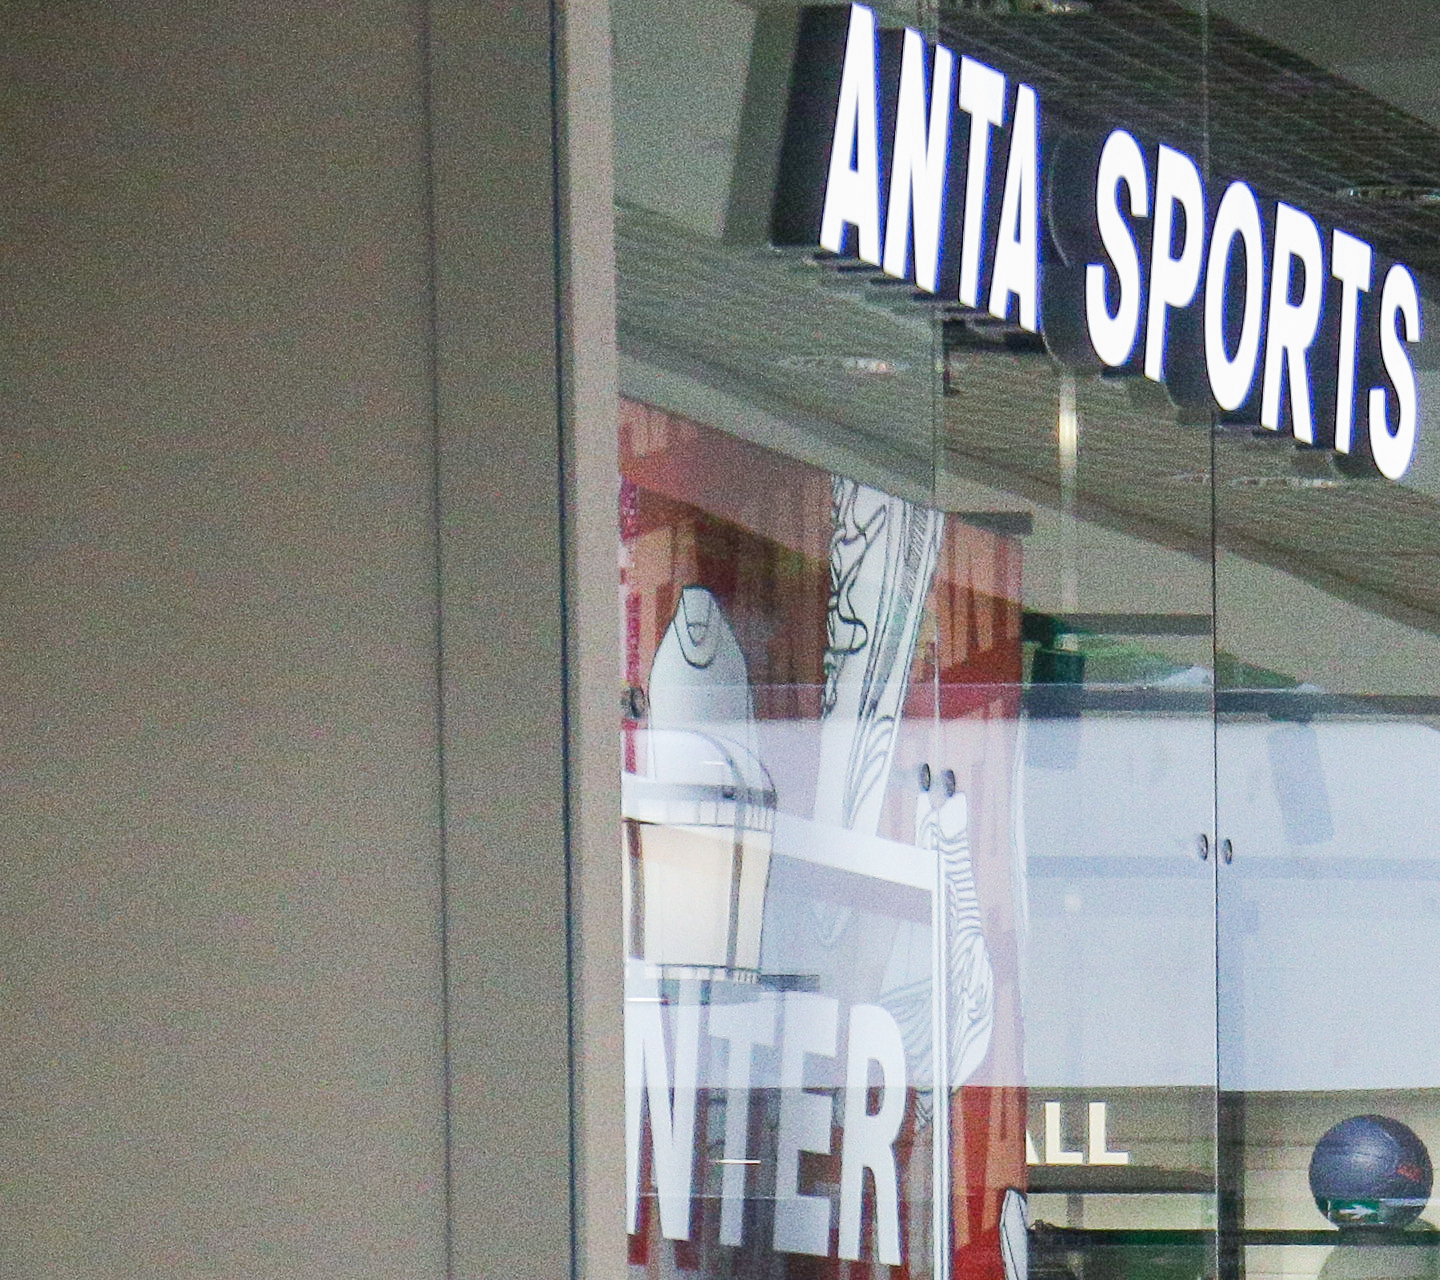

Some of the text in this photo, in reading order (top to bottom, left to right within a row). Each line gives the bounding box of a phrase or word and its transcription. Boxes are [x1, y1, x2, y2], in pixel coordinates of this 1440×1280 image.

[819, 2, 1423, 481] ANTA SPORTS
[1027, 1101, 1130, 1166] LL
